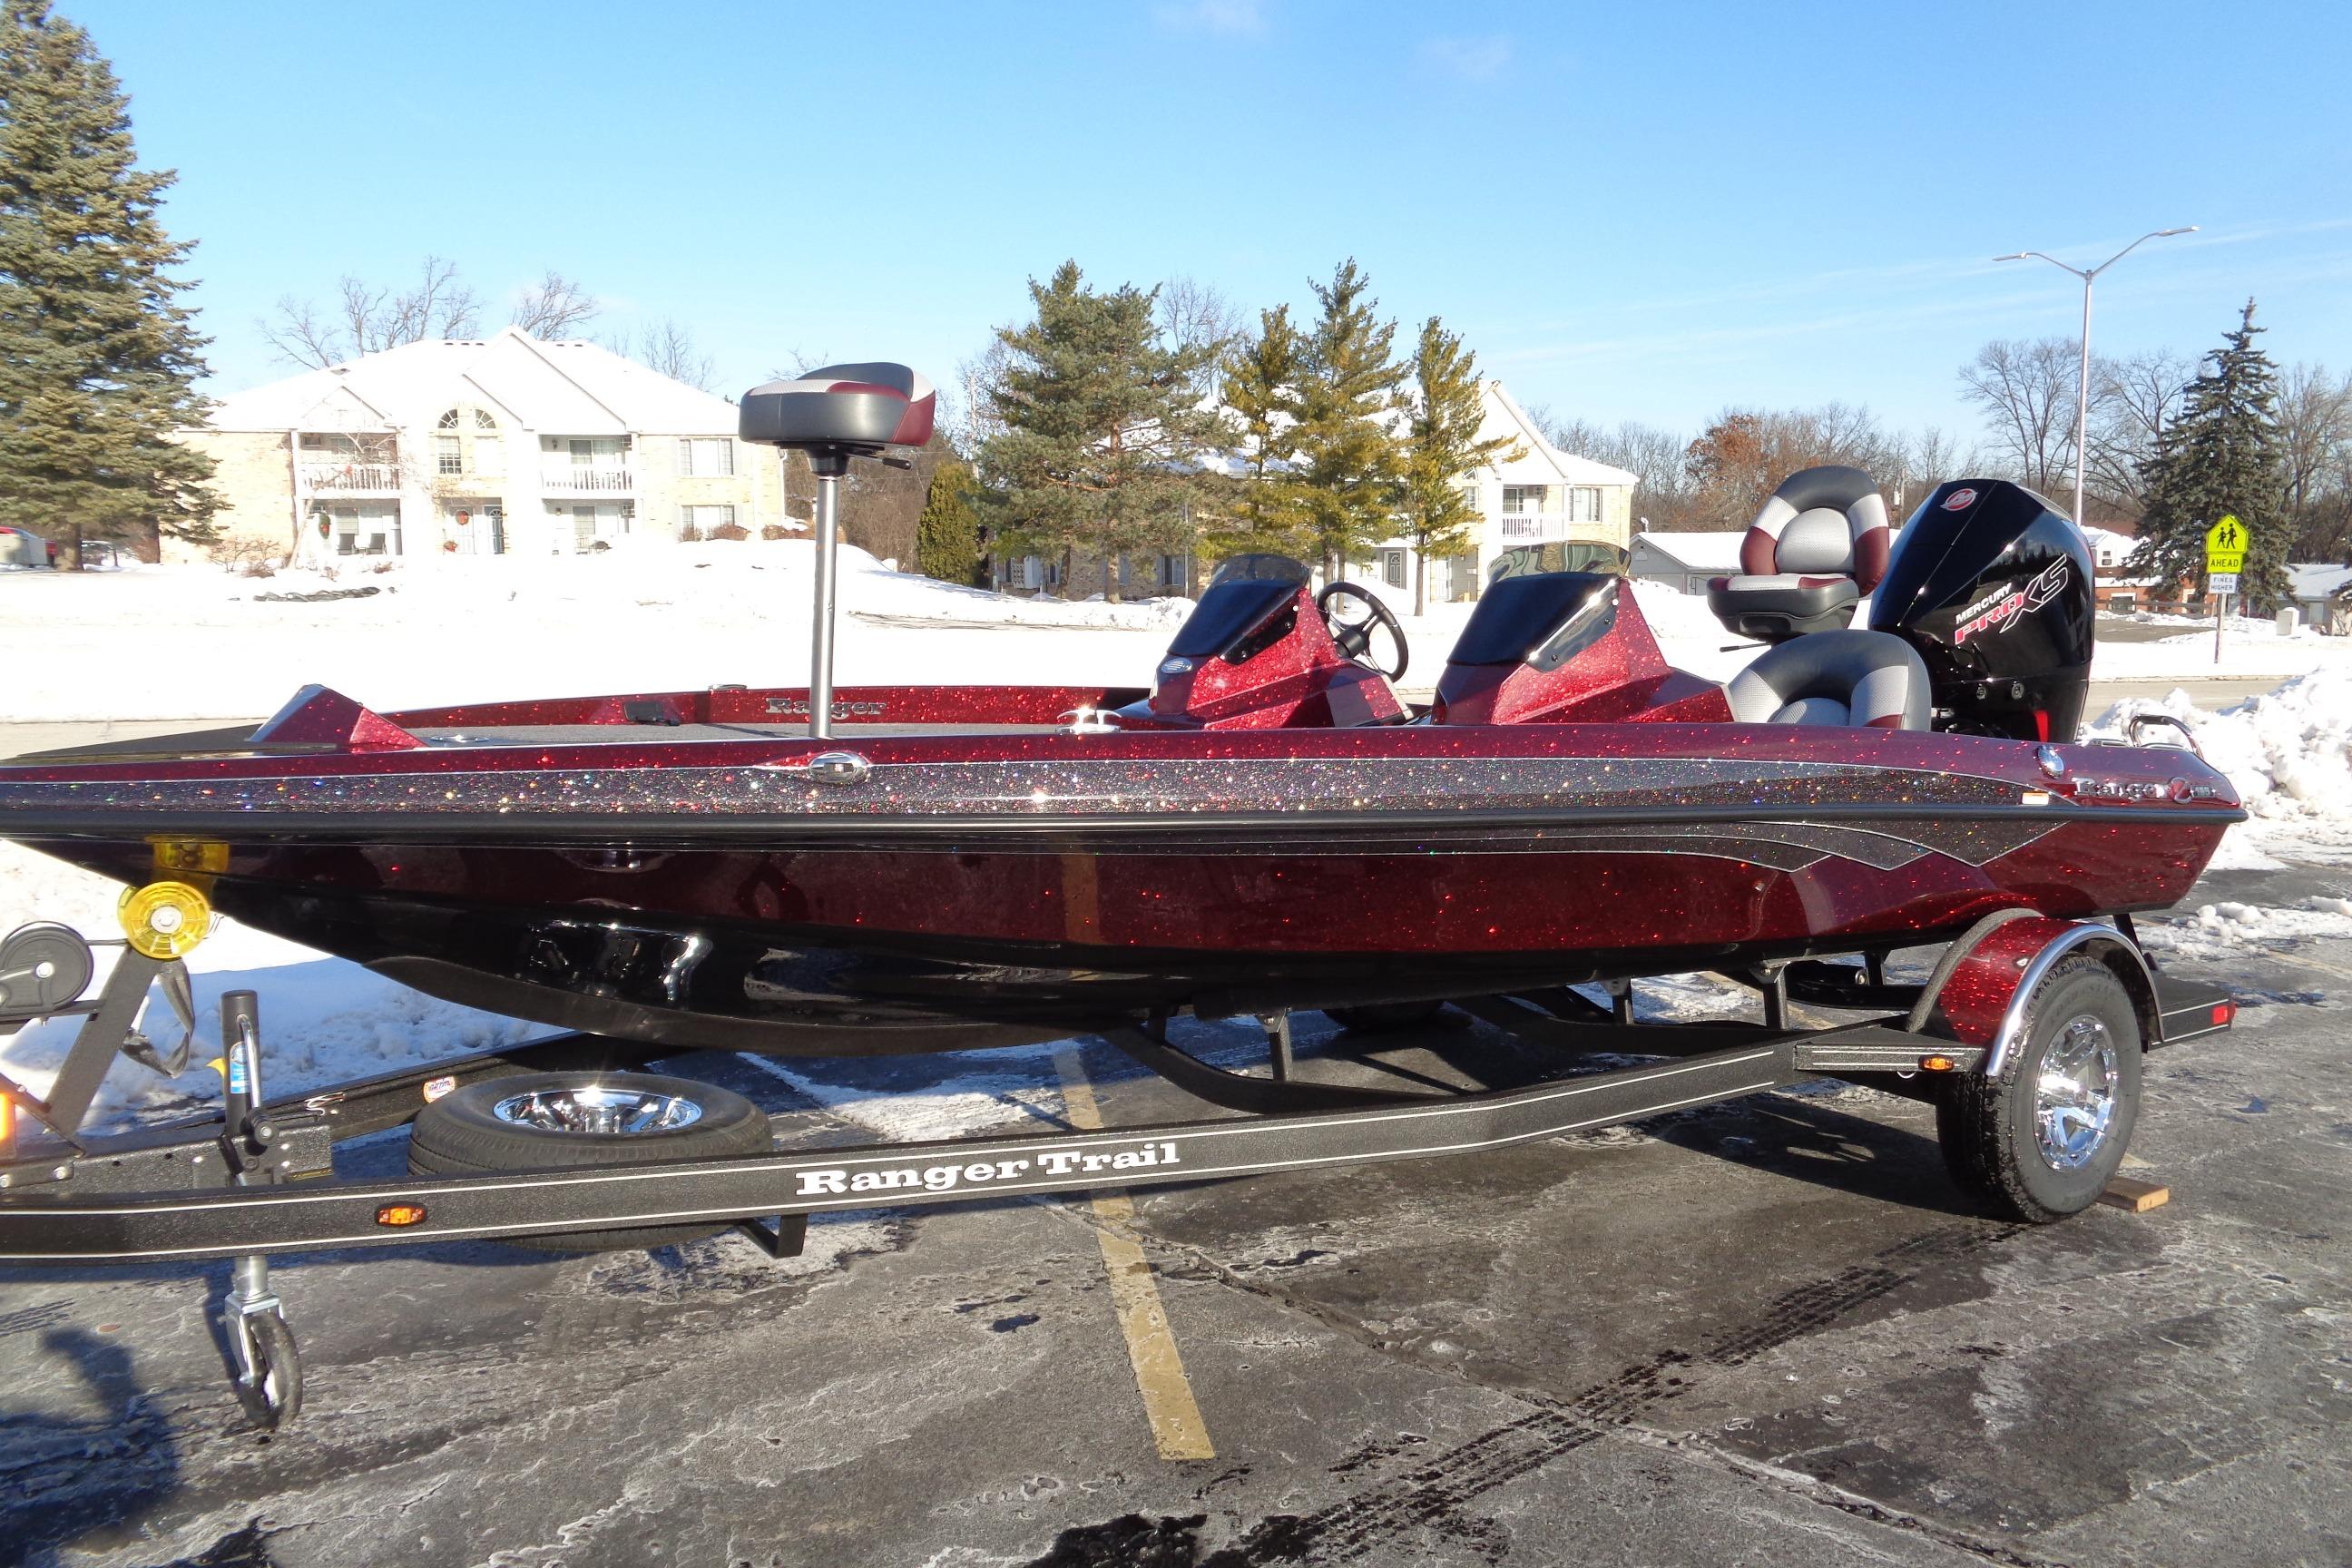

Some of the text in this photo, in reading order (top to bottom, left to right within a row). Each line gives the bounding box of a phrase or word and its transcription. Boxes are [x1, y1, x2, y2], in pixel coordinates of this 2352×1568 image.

[2210, 559, 2239, 567] AHEAD
[1955, 583, 2013, 624] MERCURY
[765, 698, 887, 720] Rager
[2072, 777, 2170, 802] Ranger
[796, 1142, 1181, 1195] Ranger Trail
